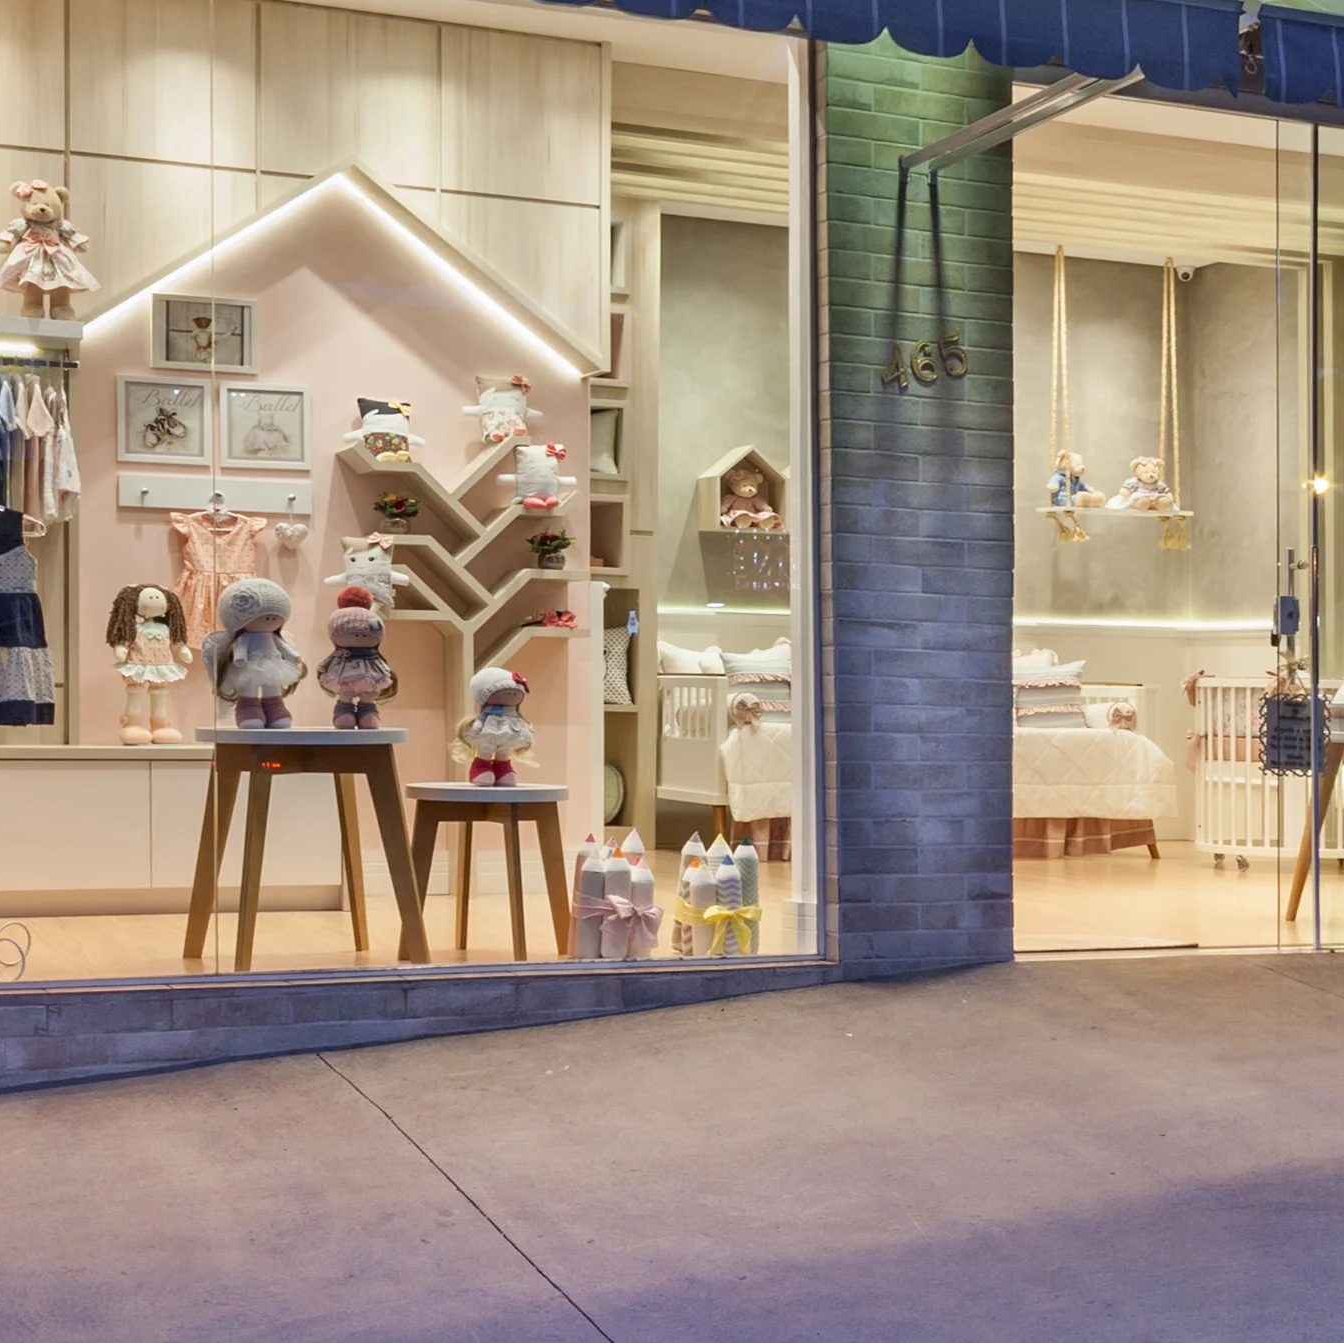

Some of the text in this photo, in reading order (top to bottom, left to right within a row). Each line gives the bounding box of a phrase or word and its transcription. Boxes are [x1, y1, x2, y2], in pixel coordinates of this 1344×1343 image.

[881, 329, 968, 389] 465
[138, 387, 203, 408] Ballet
[243, 394, 303, 413] Ballet
